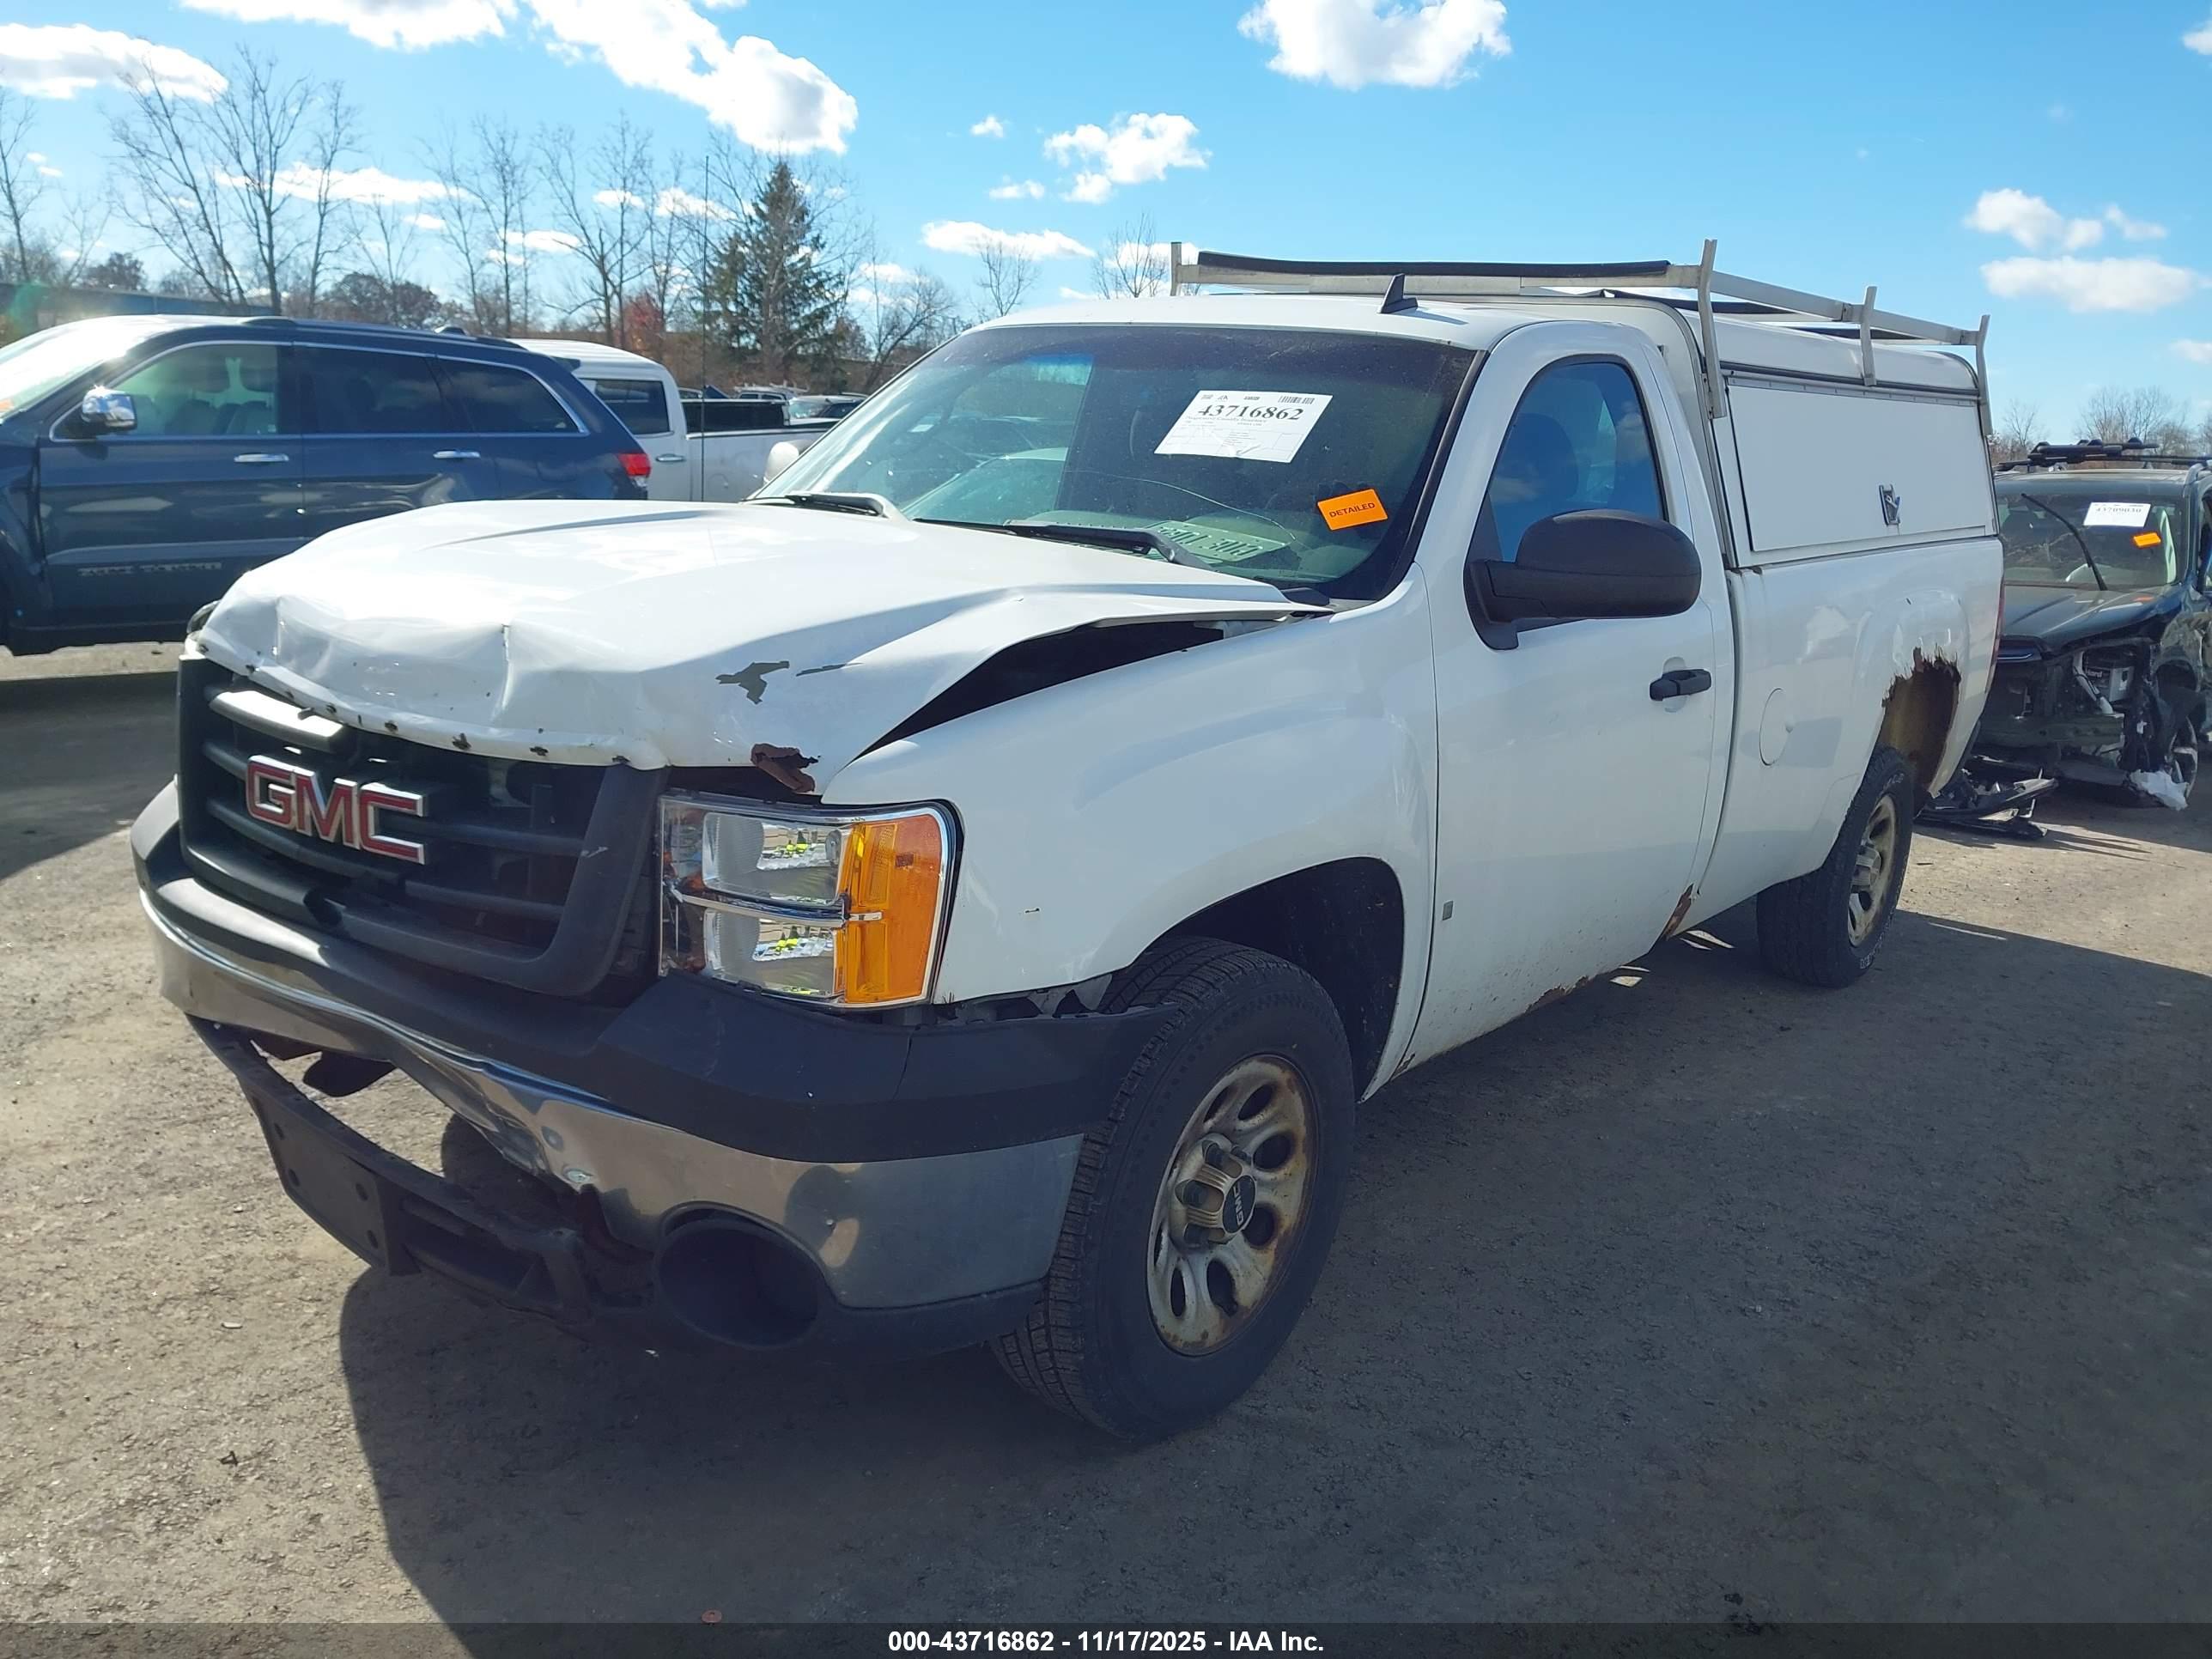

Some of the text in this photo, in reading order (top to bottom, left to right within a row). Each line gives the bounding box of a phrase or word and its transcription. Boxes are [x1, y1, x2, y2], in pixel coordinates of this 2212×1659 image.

[1198, 404, 1304, 420] 43716862
[1328, 501, 1376, 518] DETAILED
[246, 755, 425, 865] GMC
[1233, 1182, 1243, 1225] GMC
